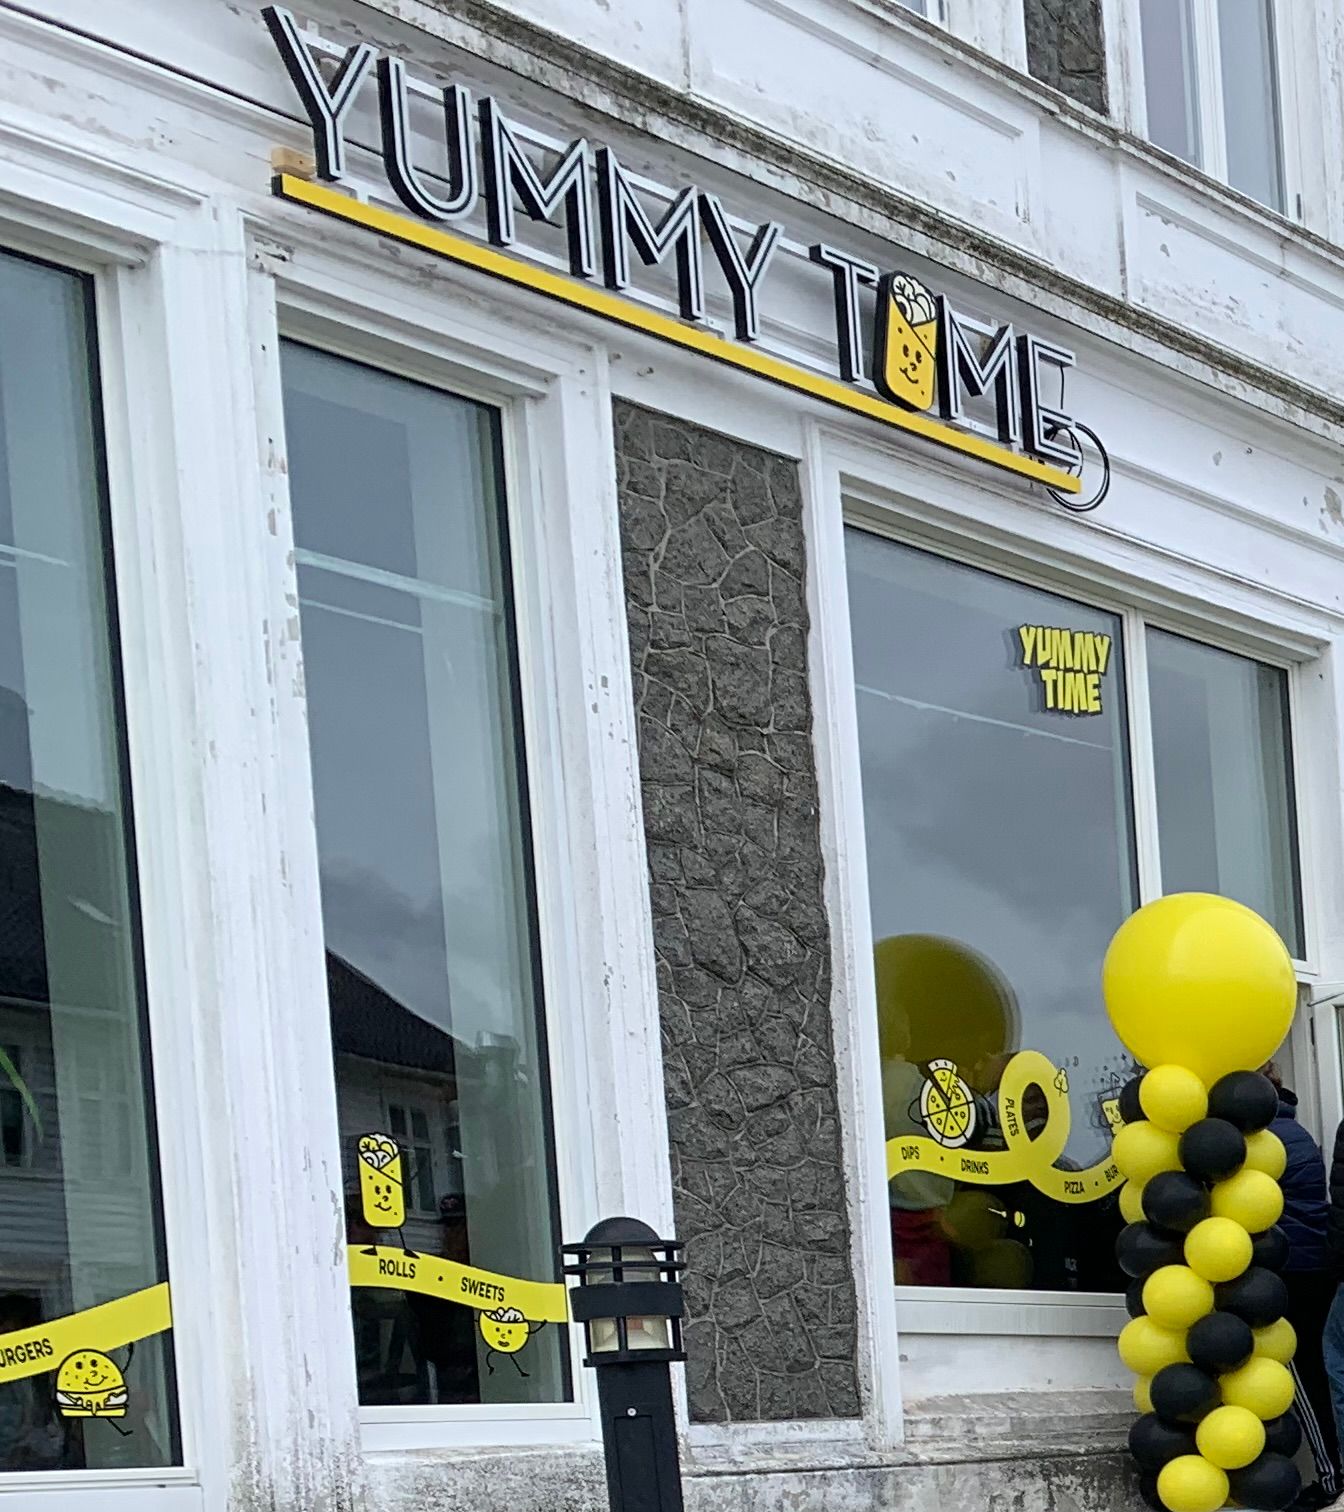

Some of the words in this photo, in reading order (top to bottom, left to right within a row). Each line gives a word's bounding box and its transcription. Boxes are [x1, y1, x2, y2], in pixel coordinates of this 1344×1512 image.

[262, 5, 784, 341] YUMMY
[1019, 624, 1111, 674] YUMMY
[1040, 668, 1102, 714] TIME
[1005, 1097, 1019, 1137] PLATES
[901, 1145, 920, 1160] DIPS
[961, 1158, 989, 1175] DRINKS
[1064, 1180, 1085, 1195] PIZZA
[379, 1258, 416, 1279] ROLLS
[461, 1276, 505, 1302] SWEETS
